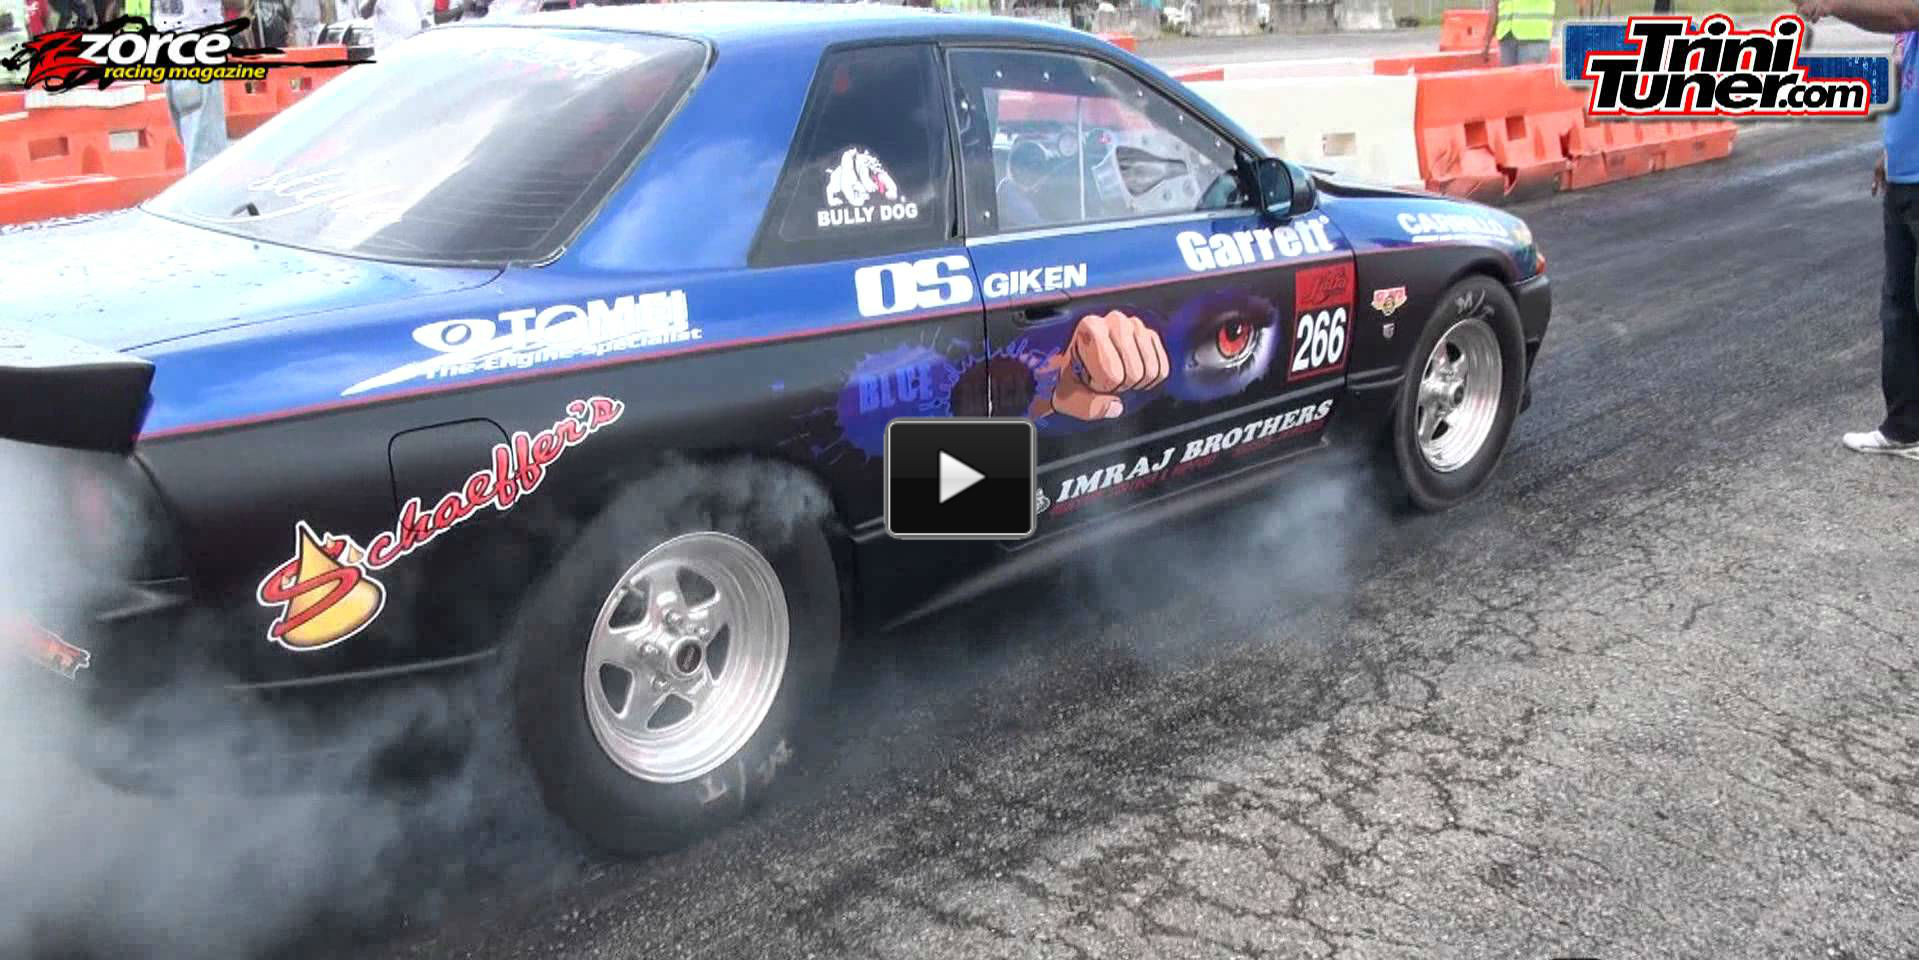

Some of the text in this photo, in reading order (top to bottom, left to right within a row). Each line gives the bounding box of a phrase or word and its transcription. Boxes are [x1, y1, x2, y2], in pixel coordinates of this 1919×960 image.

[817, 203, 919, 227] BULLY DOG
[1175, 218, 1335, 272] Garrett
[854, 255, 1088, 317] OS GIKEN
[498, 289, 690, 350] TOMEI
[1291, 307, 1348, 373] 266
[1056, 447, 1176, 503] IMRAJ
[1180, 398, 1334, 464] BROTHERS
[257, 396, 624, 650] Schaeffer's
